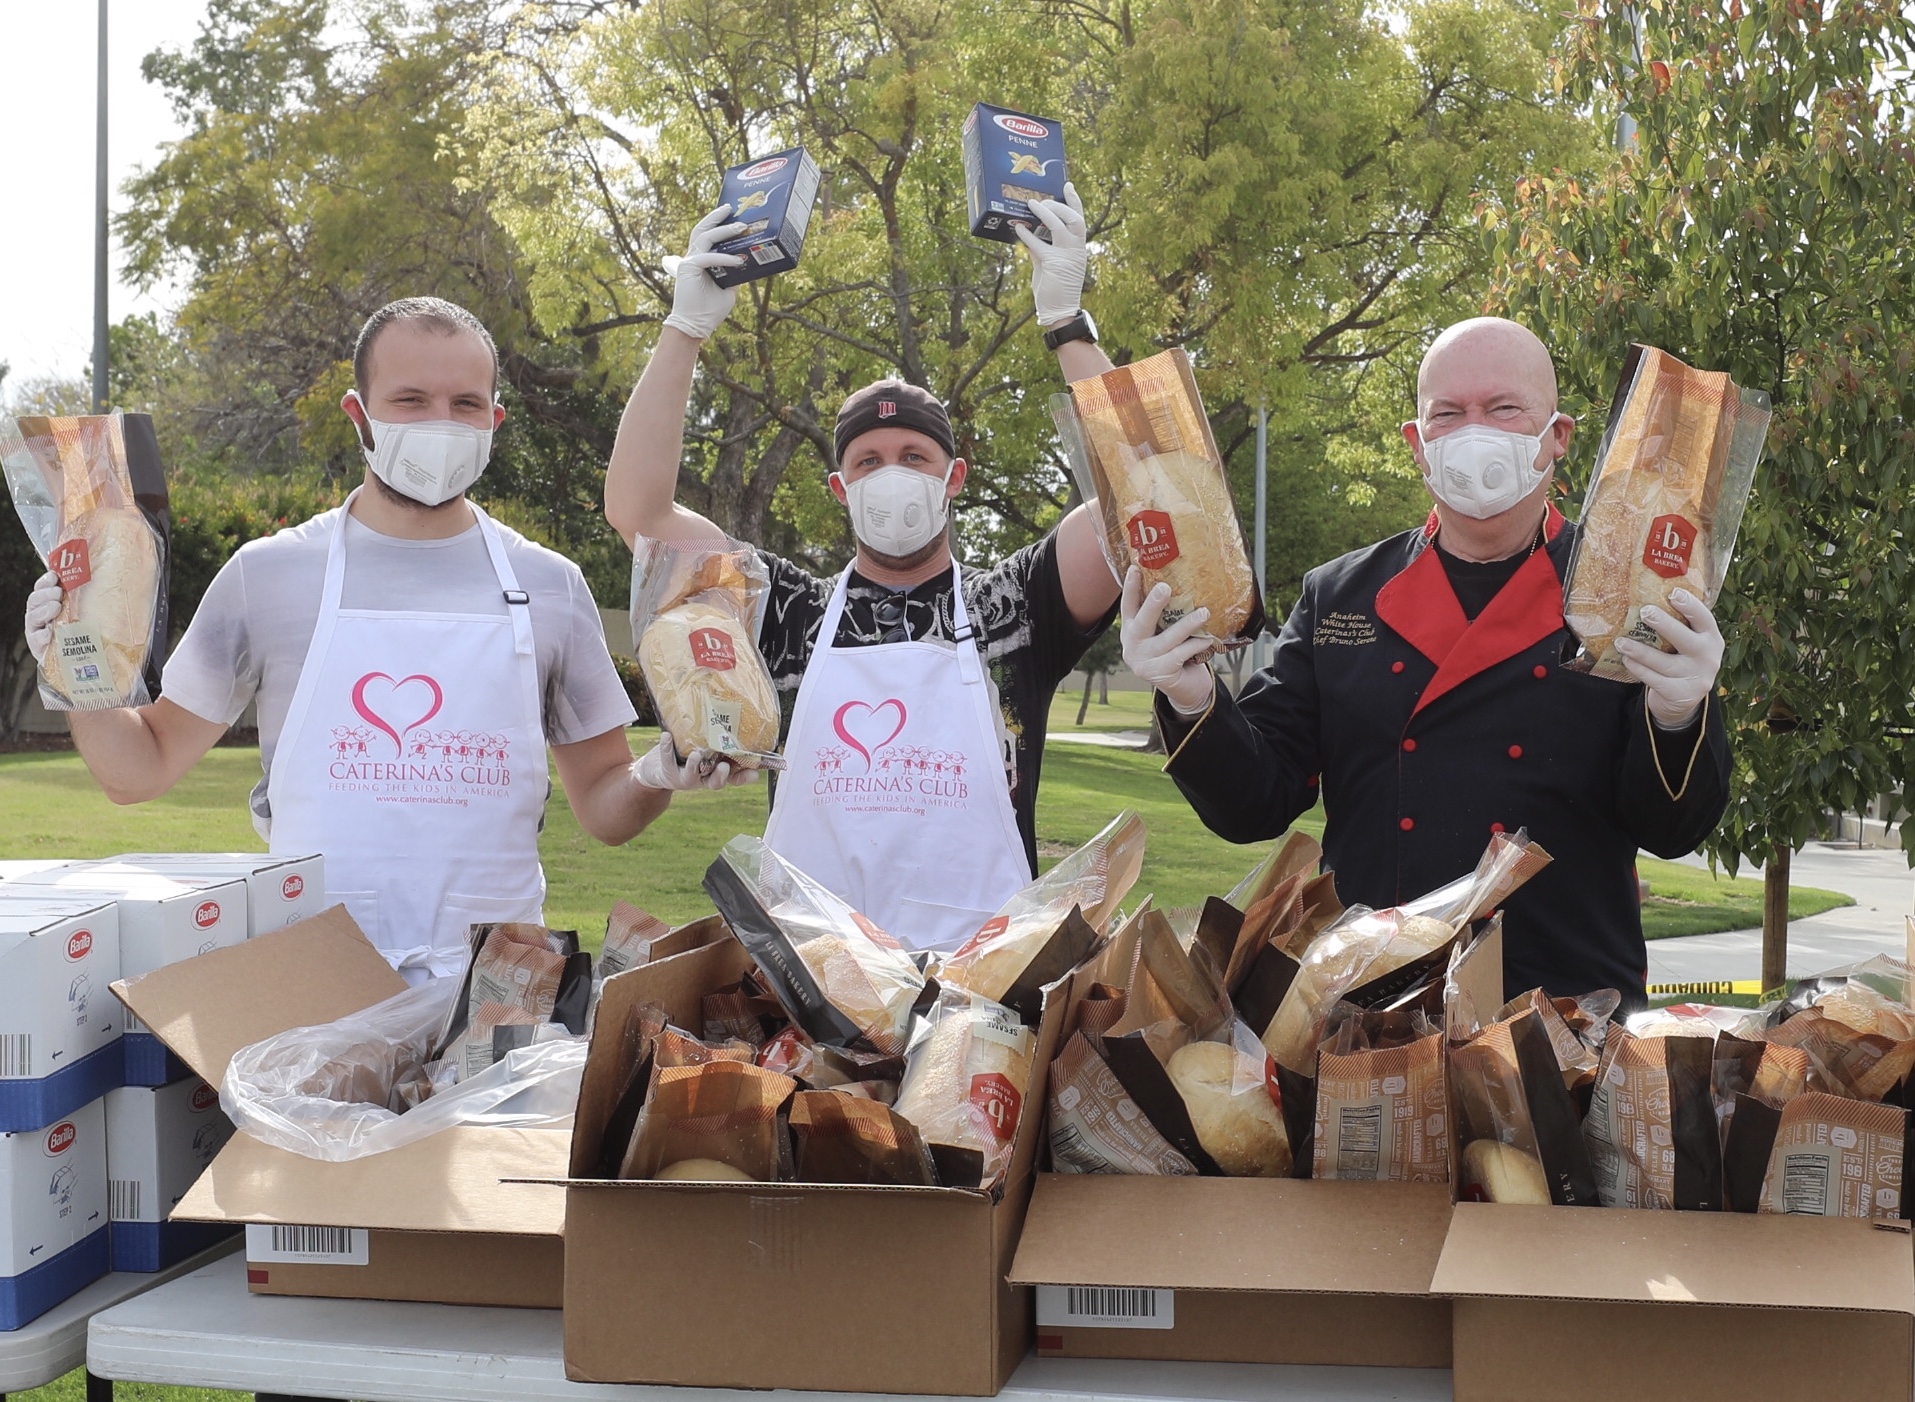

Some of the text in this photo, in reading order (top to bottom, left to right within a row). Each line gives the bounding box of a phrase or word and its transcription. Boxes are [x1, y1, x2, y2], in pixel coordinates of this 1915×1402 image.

[1006, 119, 1044, 135] Barilla
[1008, 134, 1039, 148] PENNE
[749, 160, 785, 177] Barilla
[743, 176, 772, 188] PENNE
[1138, 520, 1158, 546] b
[1662, 522, 1679, 551] b
[1148, 543, 1171, 554] BREA
[1651, 549, 1684, 563] LA BREA
[60, 549, 76, 569] b
[62, 567, 83, 577] BREA
[1321, 618, 1372, 629] White House
[1329, 611, 1366, 621] Anaheim
[1358, 627, 1376, 637] Club
[63, 635, 91, 647] SESAME
[703, 632, 721, 651] b
[1329, 636, 1354, 645] Bruno
[62, 644, 98, 657] SEMOLINA
[700, 651, 711, 659] LA
[329, 762, 511, 786] CATERINA'S CLUB
[328, 782, 510, 798] FEEDING THE KIDS IN AMERICA
[813, 776, 968, 799] CATERINA'S CLUB
[376, 795, 468, 807] www.caterinasclub.org
[812, 794, 968, 810] FEEDING THE KIDS IN AMERICA
[845, 805, 926, 816] www.caterinasclub.org
[283, 878, 304, 898] Barilla
[195, 905, 221, 925] Barilla
[67, 932, 92, 955] Barilla
[1651, 981, 1733, 994] CUIDADO
[980, 1085, 1004, 1099] BREA
[50, 1127, 76, 1149] Barilla
[1105, 1111, 1143, 1151] HANDCRAFTED
[1412, 1119, 1422, 1162] HANDCRAFTED
